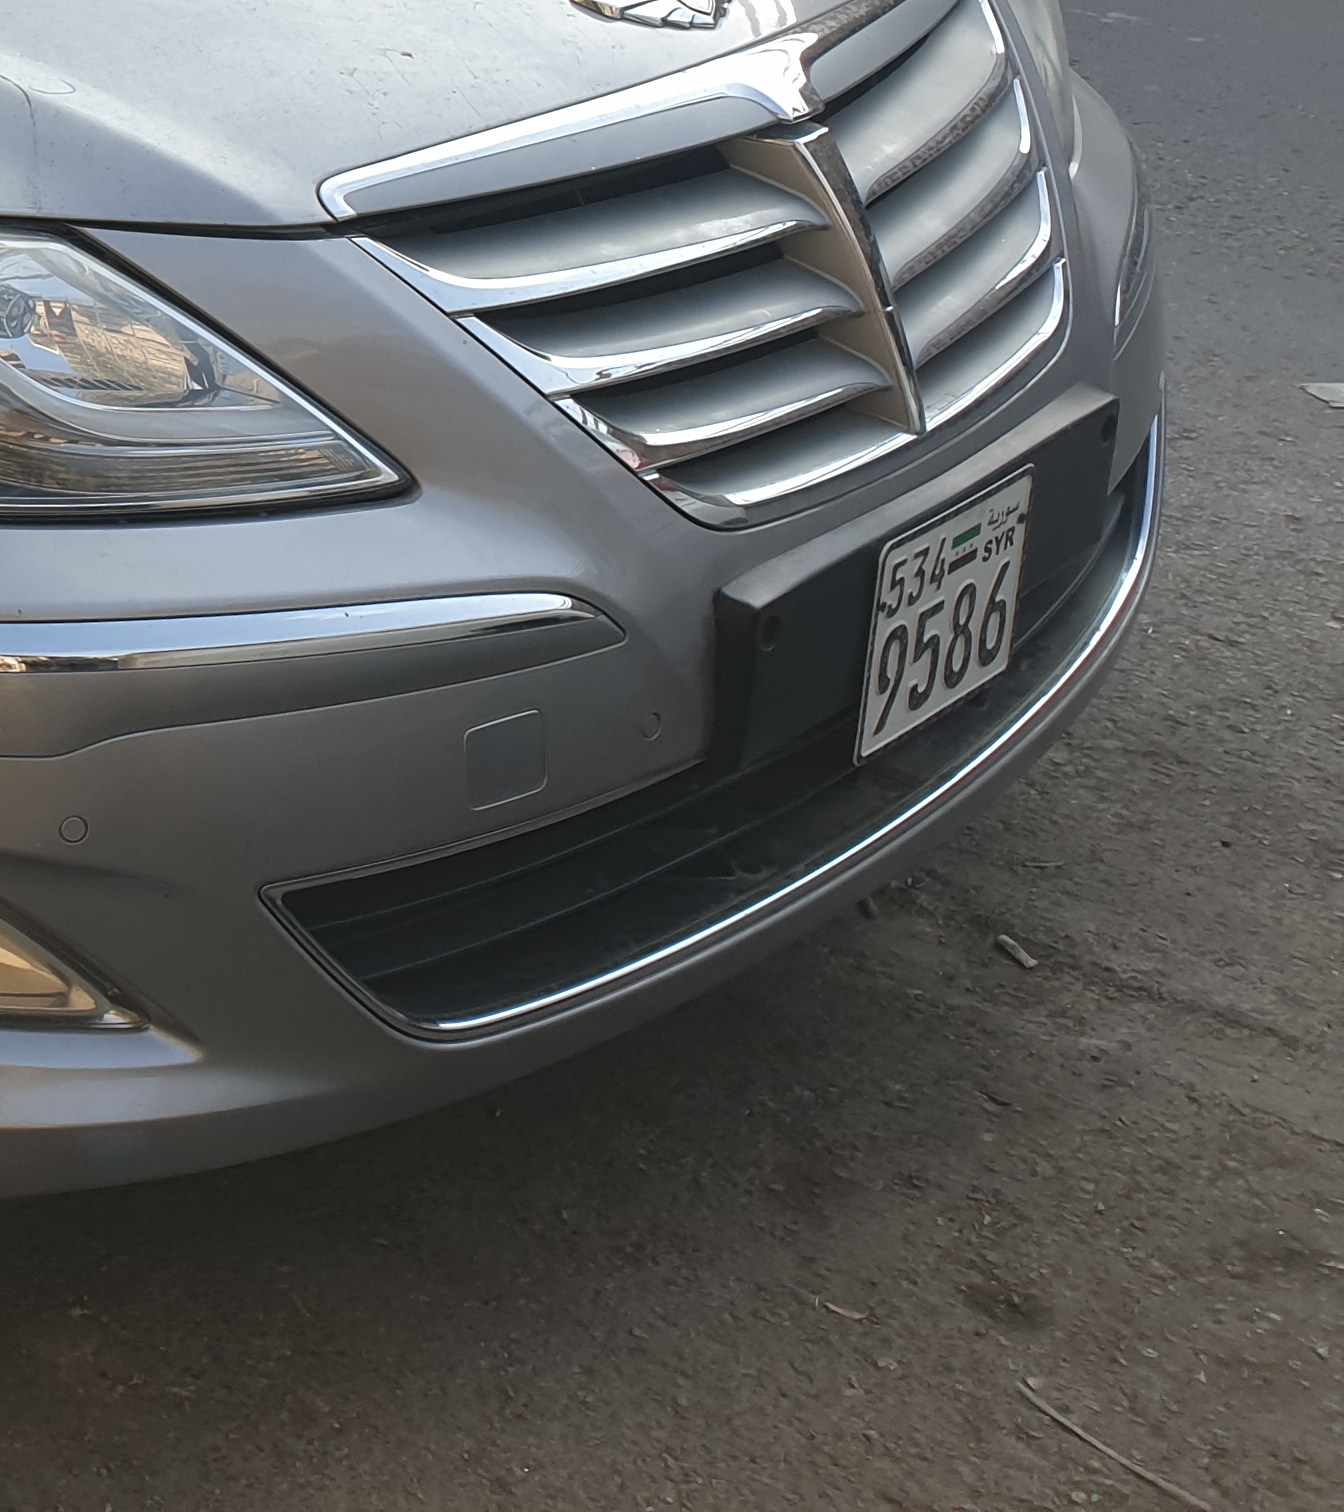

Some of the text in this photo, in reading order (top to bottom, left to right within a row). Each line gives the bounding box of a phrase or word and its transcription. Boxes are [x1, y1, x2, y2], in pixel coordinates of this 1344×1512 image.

[981, 526, 1016, 563] SYR
[986, 501, 1020, 531] سورية
[884, 535, 947, 620] 534
[872, 558, 1012, 736] 9586
